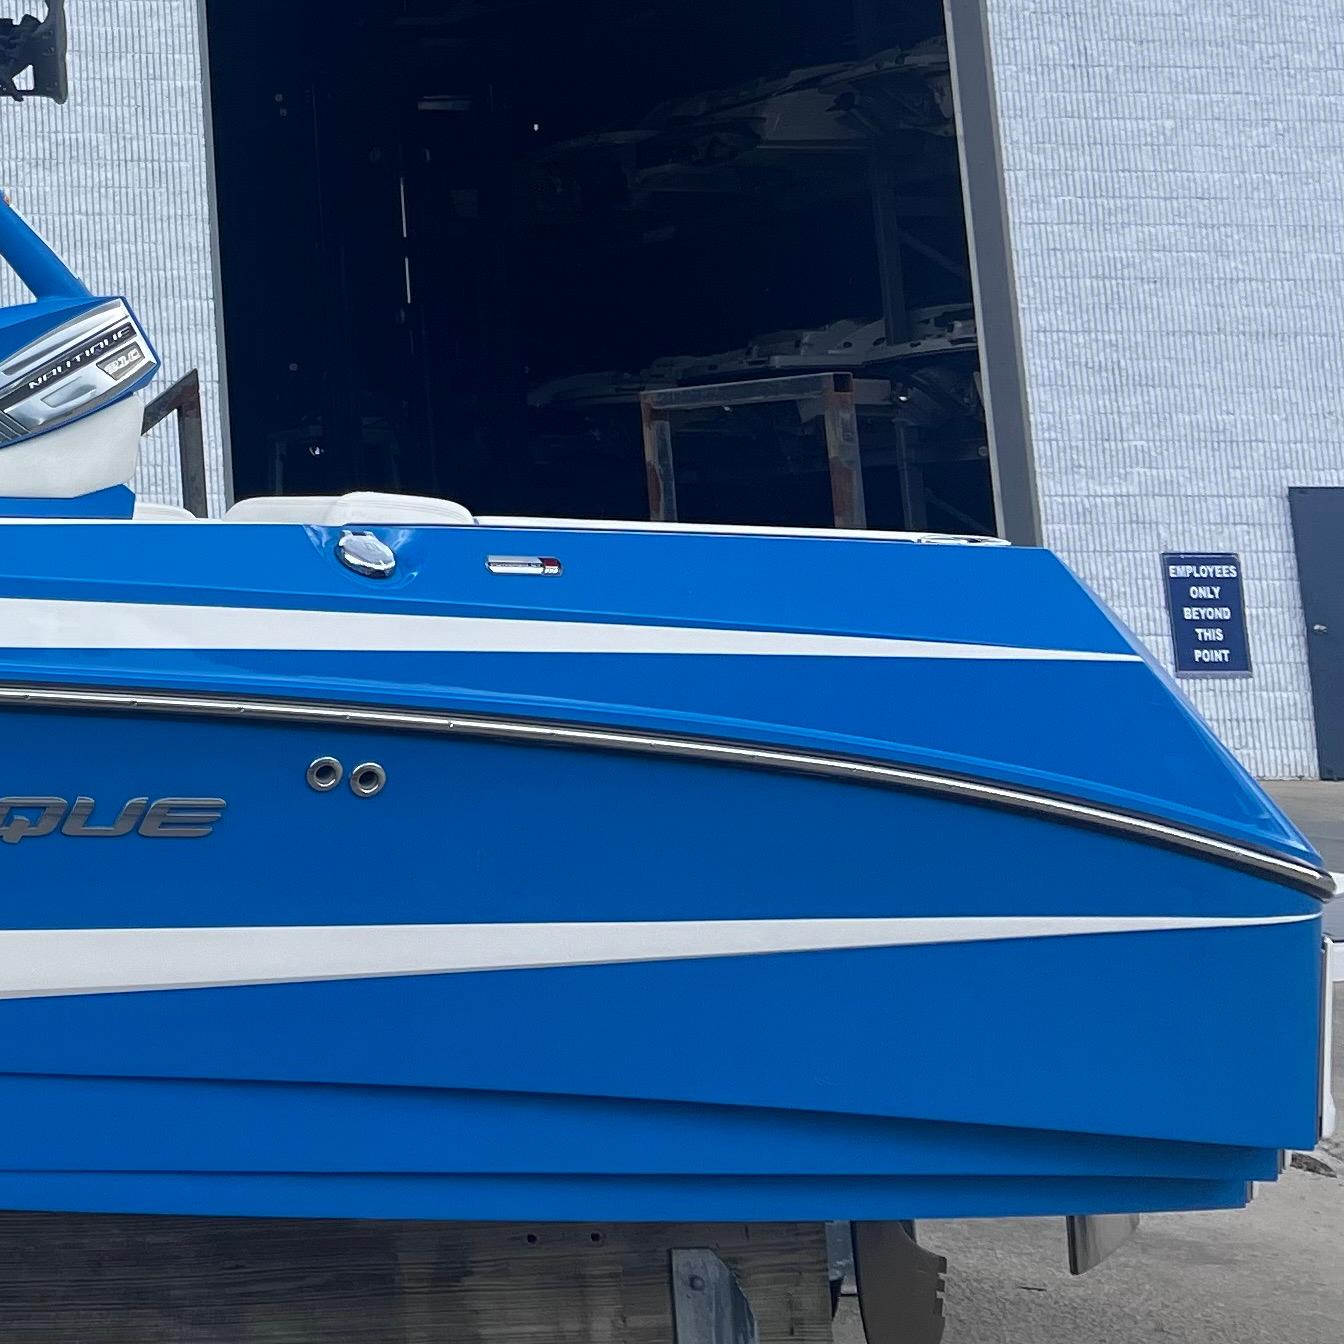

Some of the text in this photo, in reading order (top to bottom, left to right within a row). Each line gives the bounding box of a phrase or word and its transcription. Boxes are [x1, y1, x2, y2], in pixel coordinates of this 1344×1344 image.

[28, 326, 131, 390] NAUTIQUE
[1168, 564, 1238, 578] EMPLOYEES
[1189, 585, 1221, 599] ONLY
[1182, 607, 1232, 620] BEYOND
[1194, 627, 1224, 642] THIS
[1193, 648, 1231, 663] POINT
